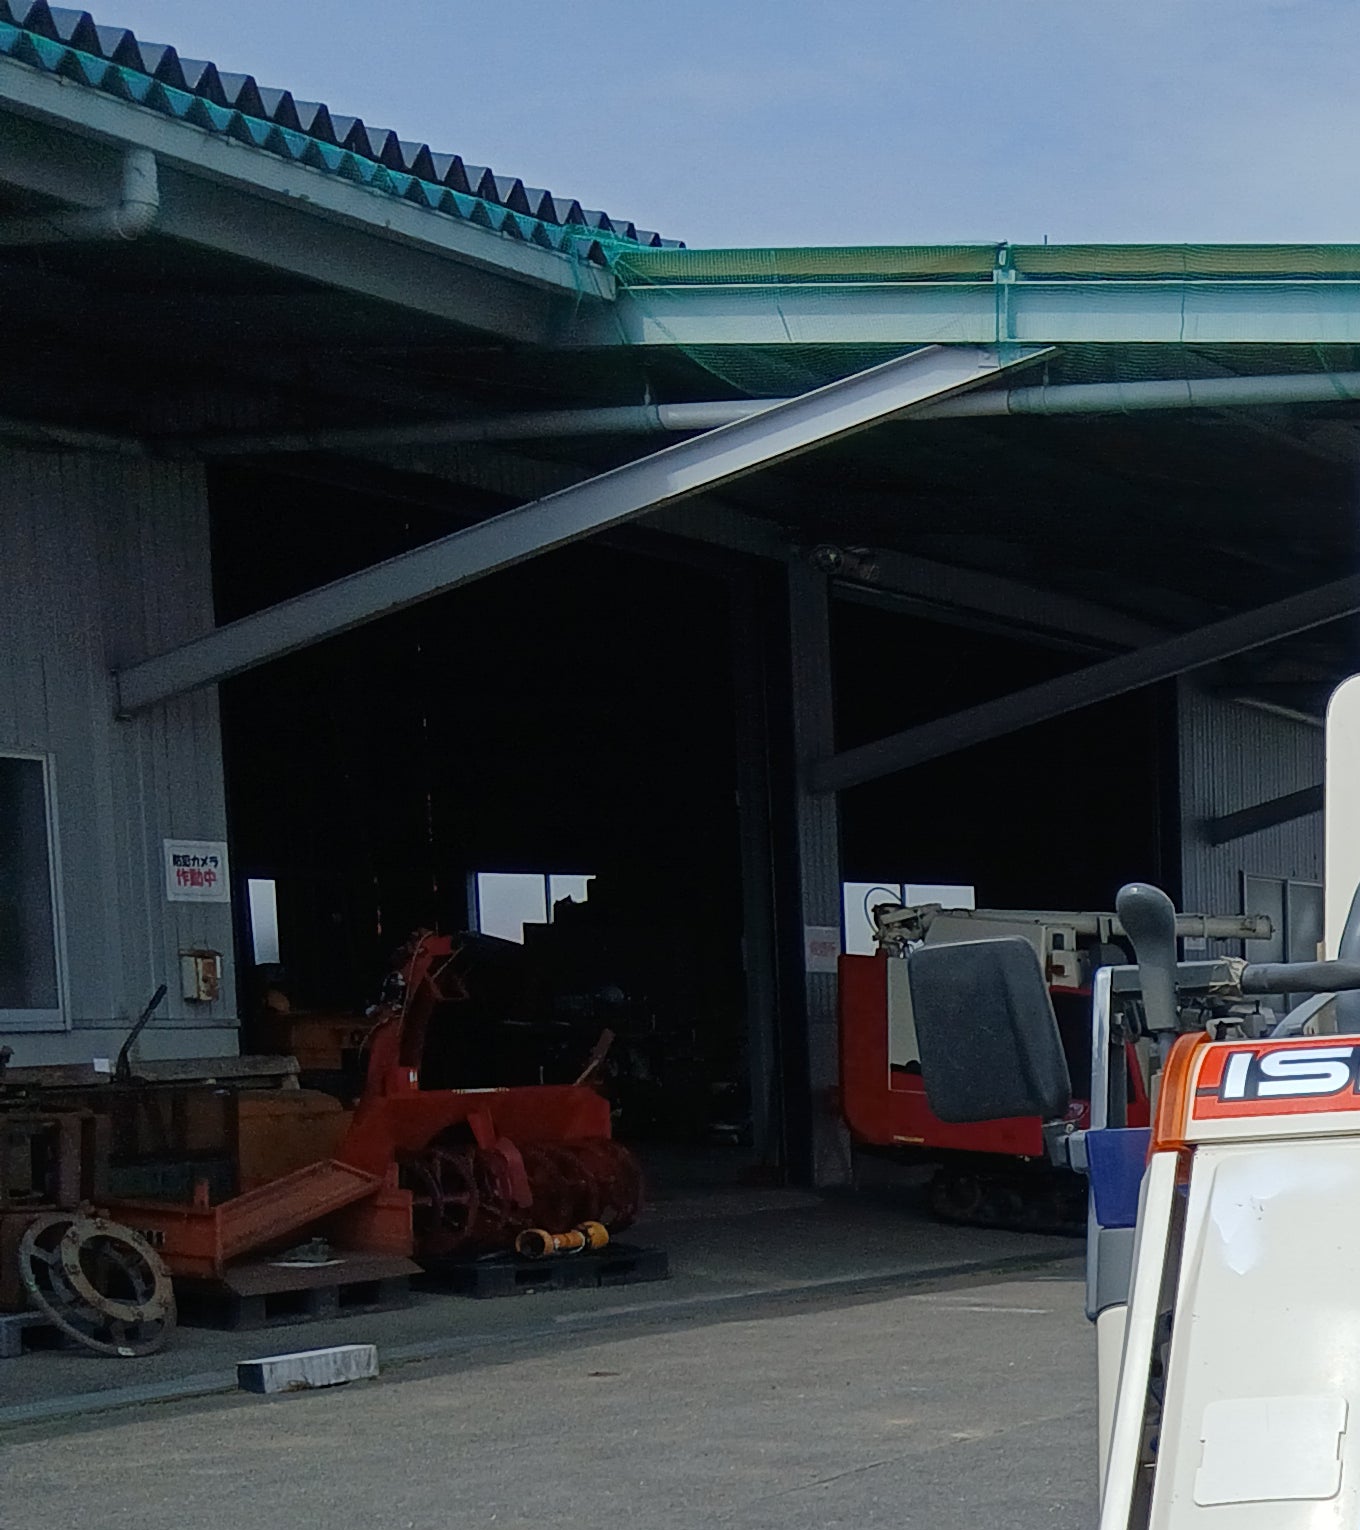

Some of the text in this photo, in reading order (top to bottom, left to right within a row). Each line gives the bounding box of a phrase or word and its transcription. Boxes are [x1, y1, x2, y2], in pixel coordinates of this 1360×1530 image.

[172, 854, 219, 869] 防犯カメラ
[176, 868, 217, 888] 作動中
